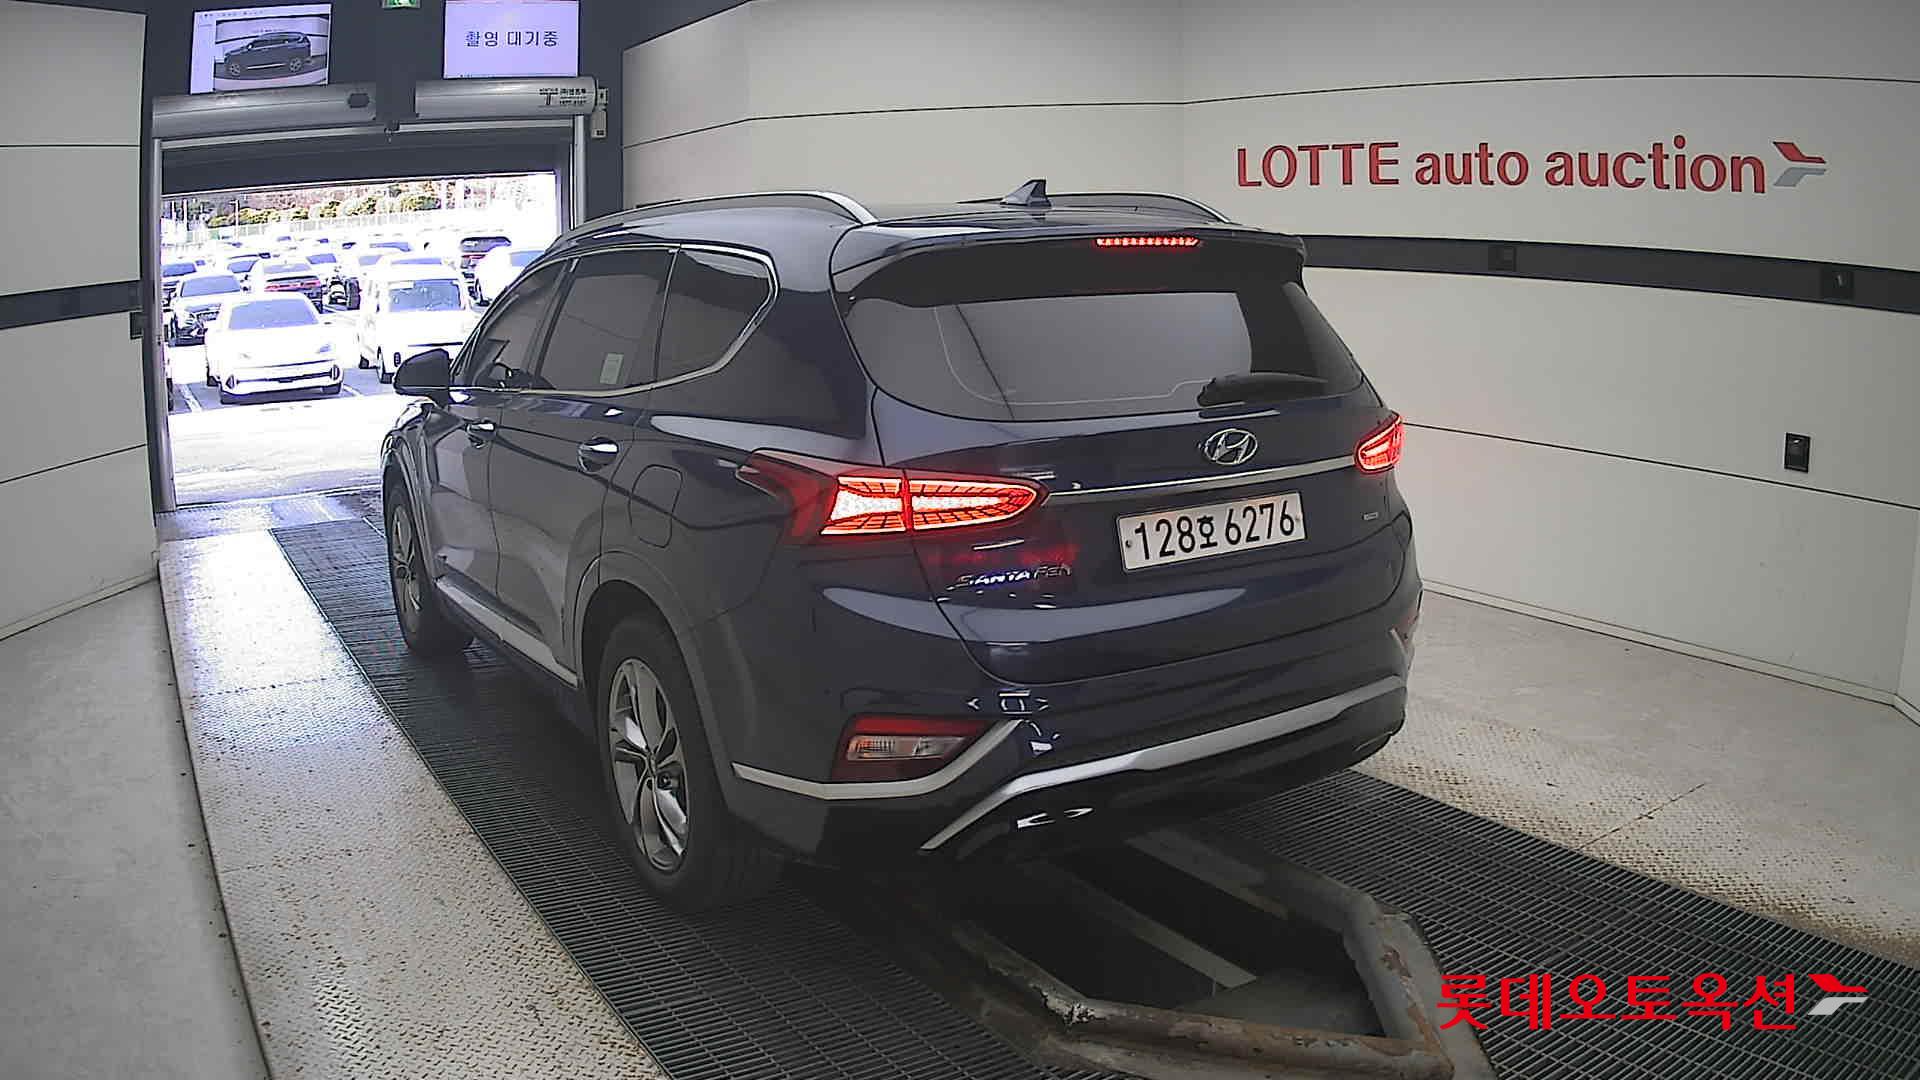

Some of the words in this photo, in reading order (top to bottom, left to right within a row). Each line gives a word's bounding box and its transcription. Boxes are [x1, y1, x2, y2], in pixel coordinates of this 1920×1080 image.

[465, 31, 498, 47] 촬영
[507, 31, 559, 47] 대기중
[1236, 142, 1400, 188] LOTTE
[1415, 143, 1530, 187] auto
[1544, 135, 1766, 194] auction
[1134, 515, 1218, 560] 128호
[1224, 500, 1296, 546] 6276
[957, 570, 1031, 587] SANTA
